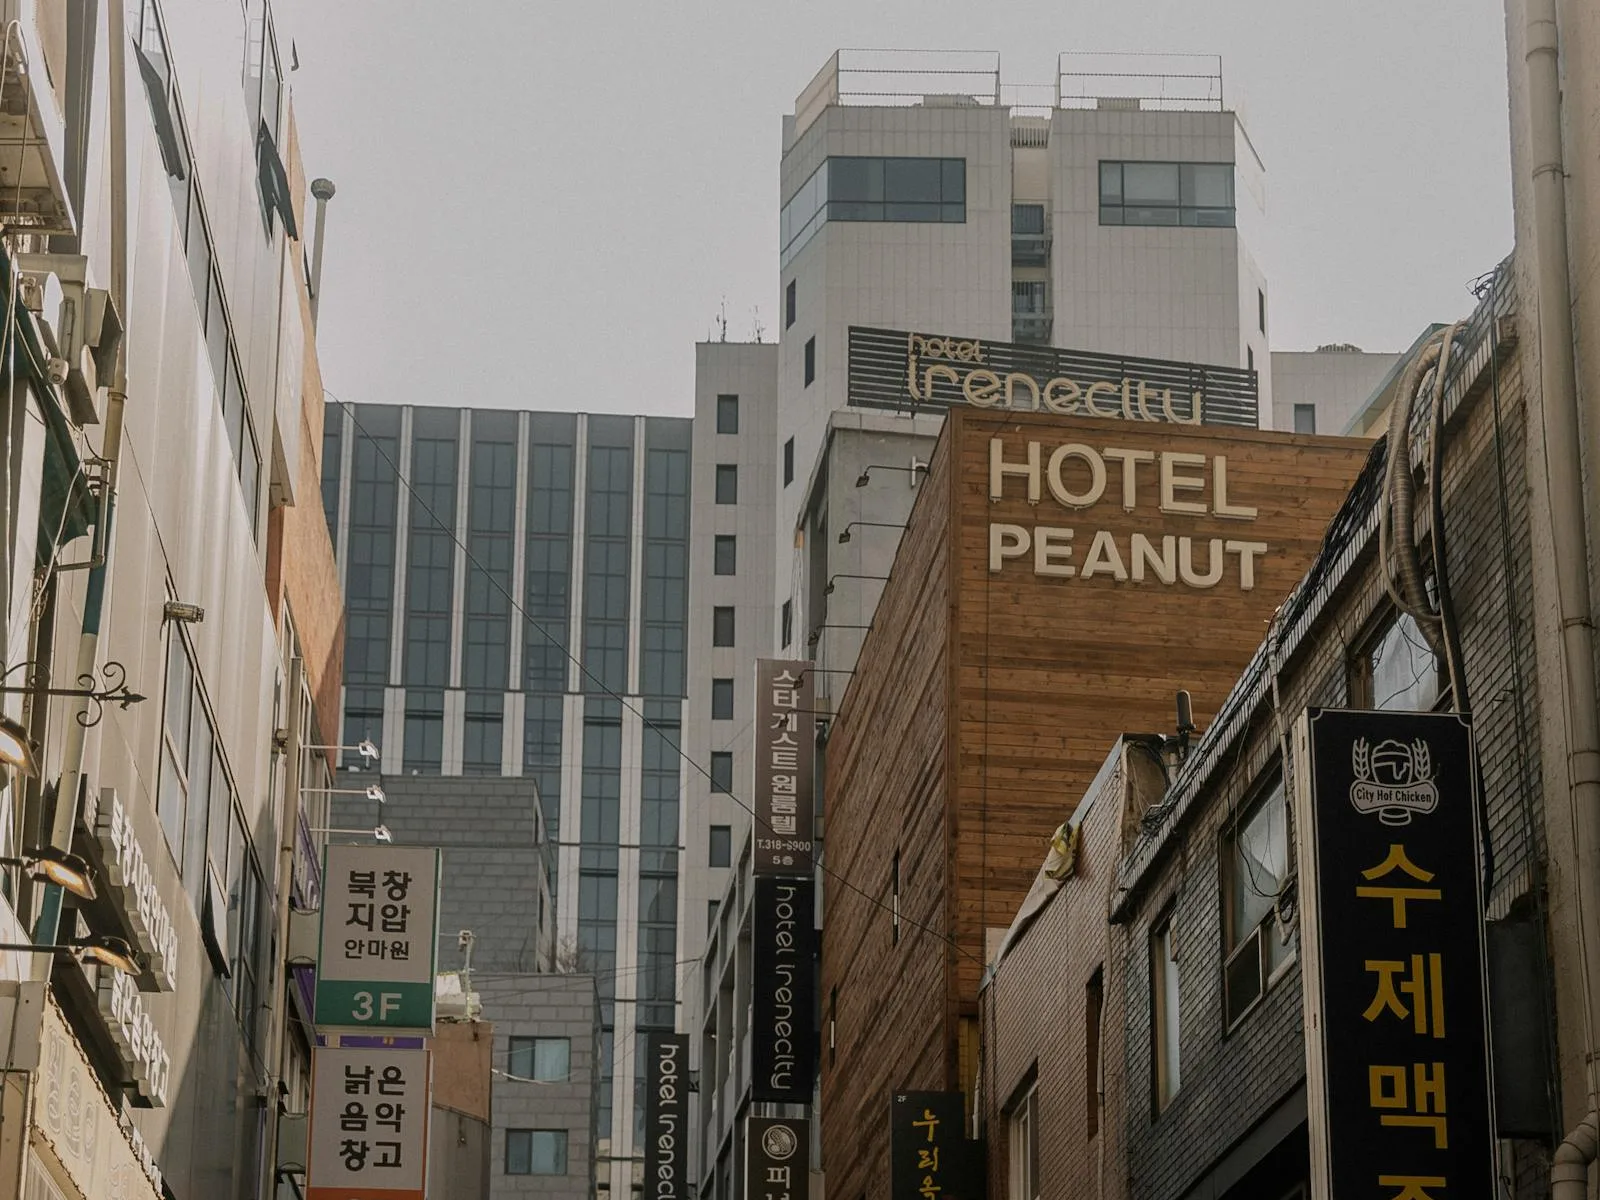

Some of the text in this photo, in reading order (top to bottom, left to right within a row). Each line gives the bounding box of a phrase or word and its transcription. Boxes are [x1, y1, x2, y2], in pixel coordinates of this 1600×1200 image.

[990, 439, 1258, 521] HOTEL
[990, 523, 1267, 591] PEANUT
[1357, 788, 1432, 803] City Hof Chicken
[348, 871, 412, 901] 북창
[346, 903, 410, 933] 지압
[776, 886, 796, 955] hotel
[345, 939, 409, 960] 안마원
[351, 991, 402, 1021] 3F
[344, 1065, 406, 1098] 낡은
[659, 1044, 679, 1107] hotel
[339, 1103, 406, 1134] 음악
[339, 1140, 402, 1172] 창고
